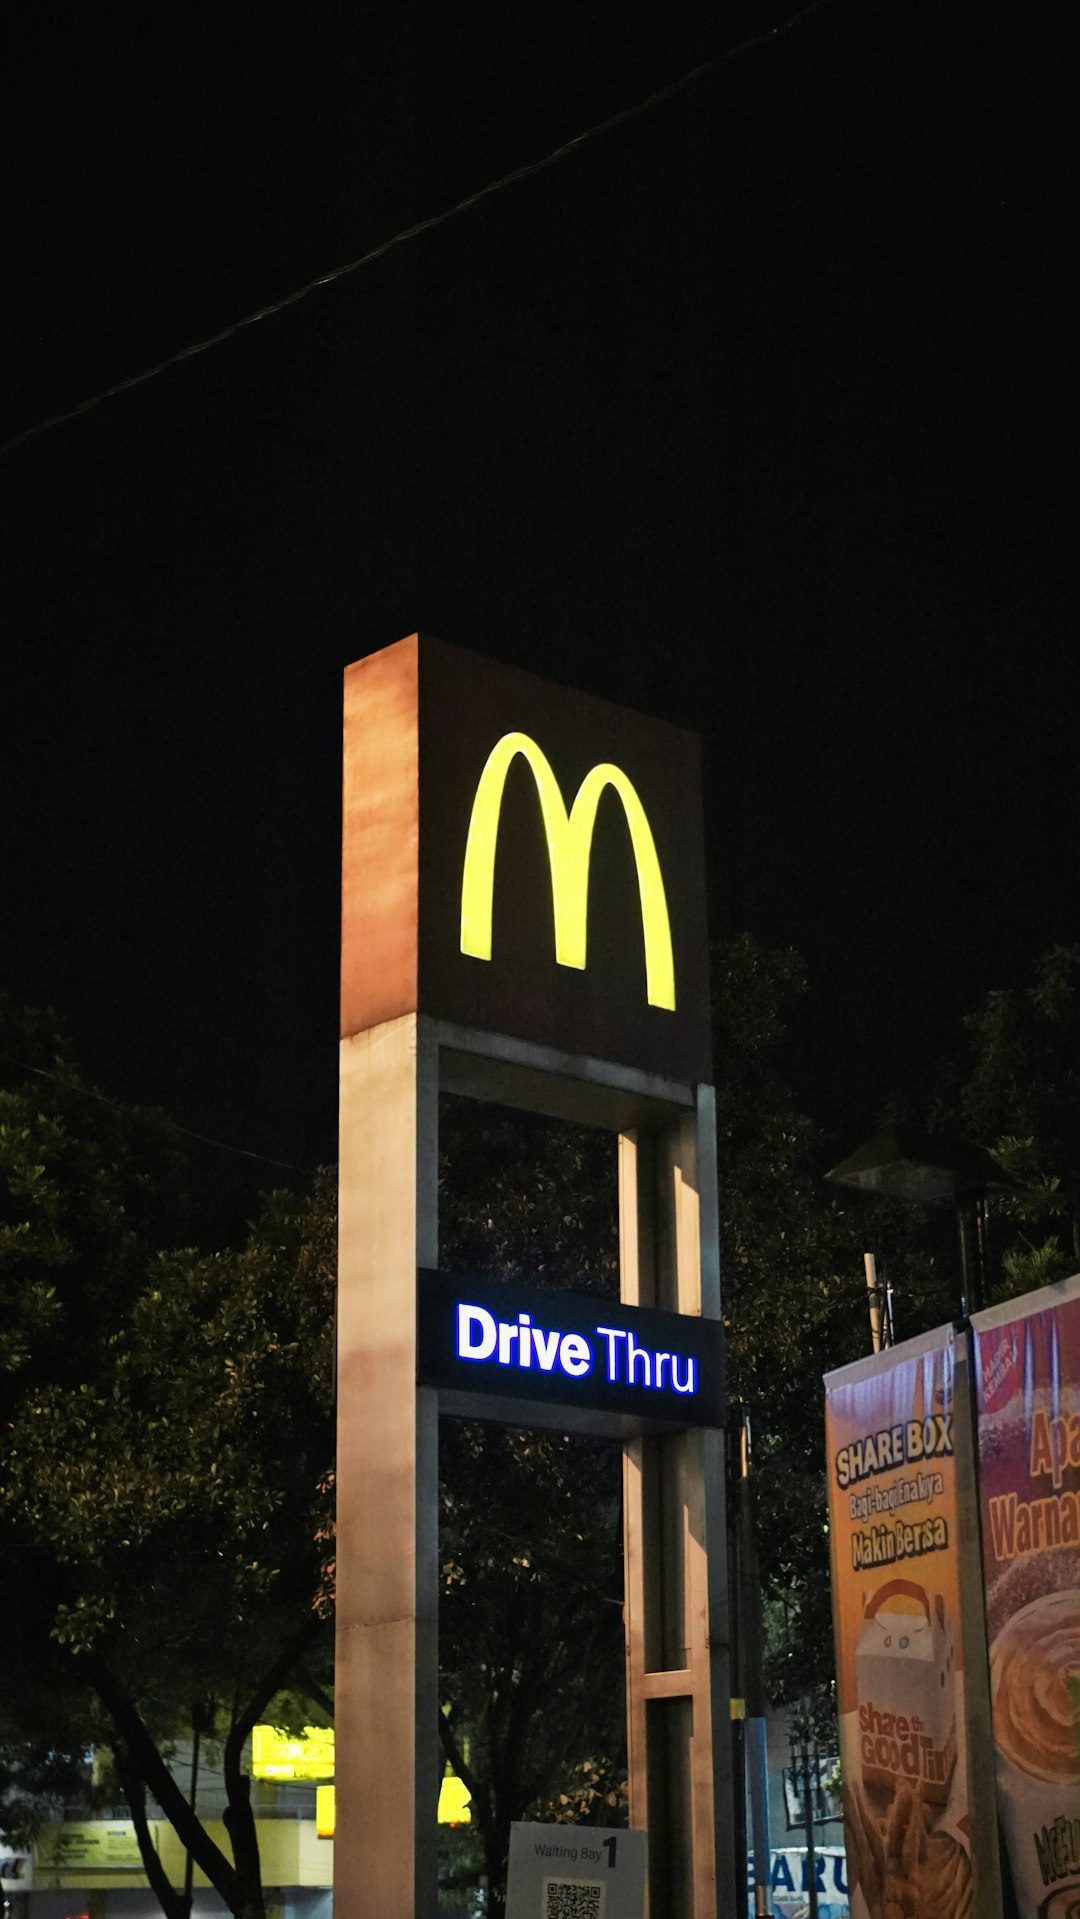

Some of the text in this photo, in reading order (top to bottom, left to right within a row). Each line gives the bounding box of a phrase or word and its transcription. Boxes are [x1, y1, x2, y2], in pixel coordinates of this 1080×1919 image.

[457, 1303, 695, 1393] Drive Thru
[836, 1413, 953, 1490] SHARE BOX
[852, 1524, 897, 1571] Makin
[535, 1836, 617, 1868] Waiting Bay 1
